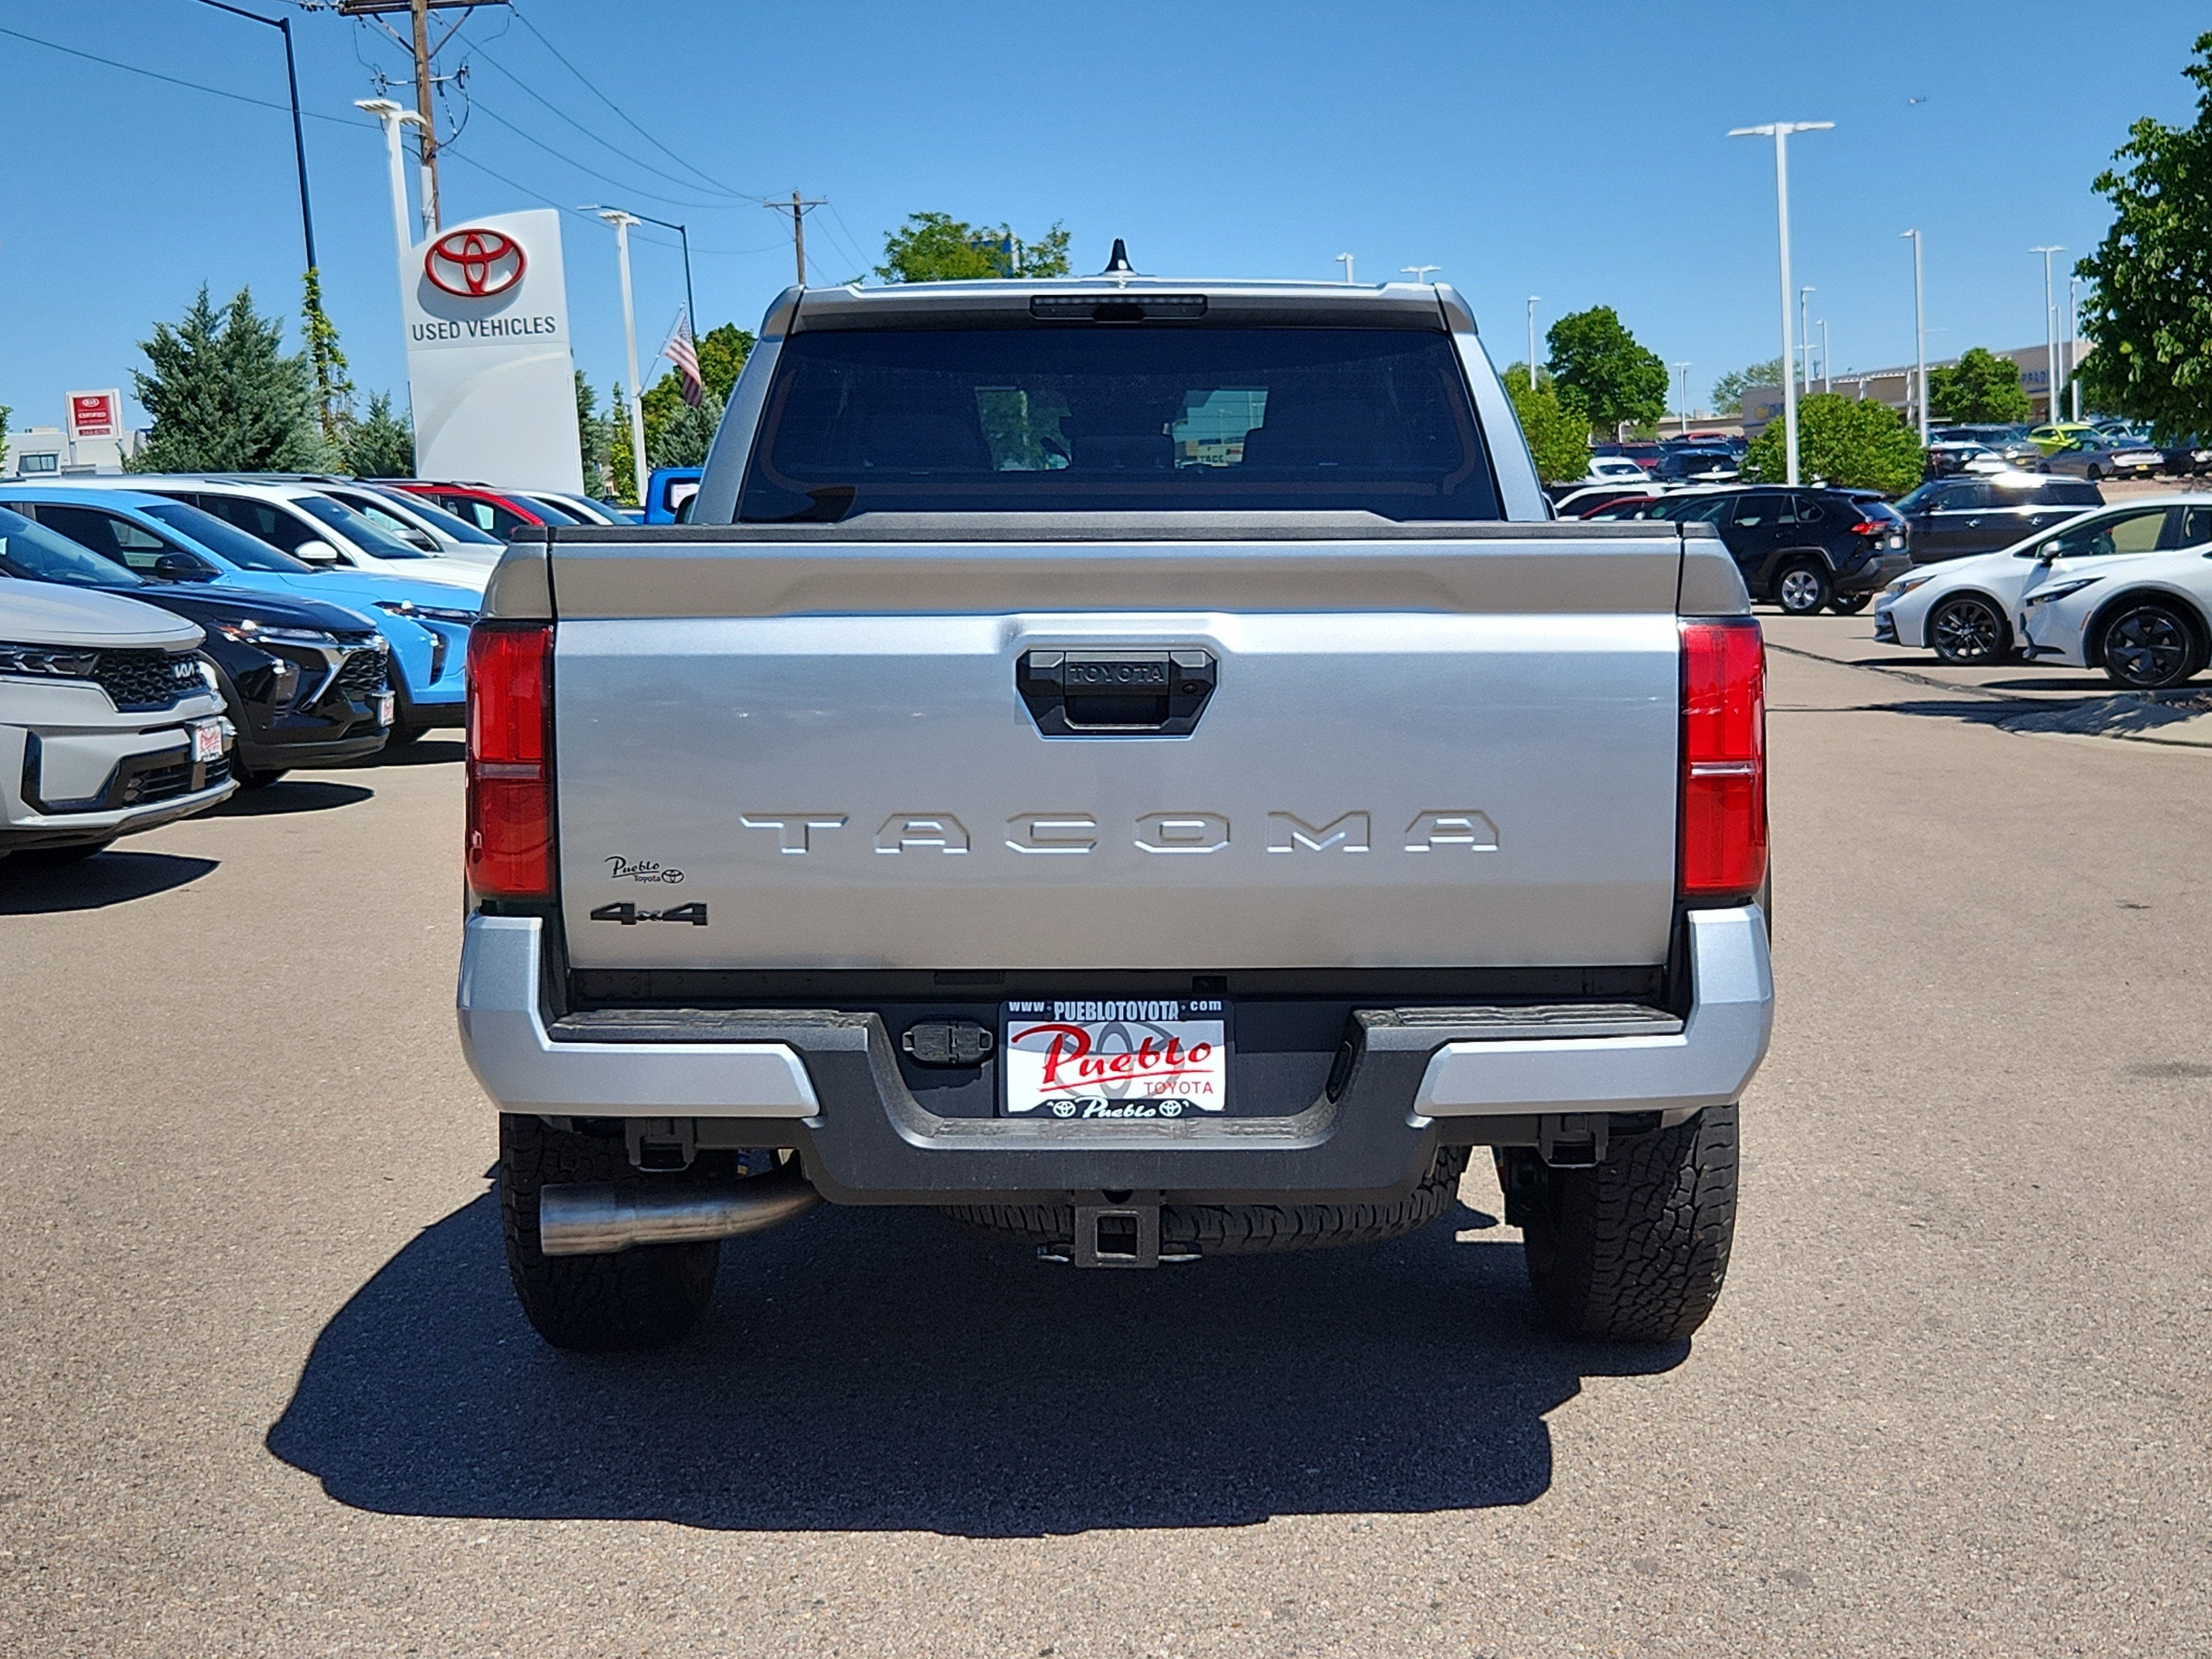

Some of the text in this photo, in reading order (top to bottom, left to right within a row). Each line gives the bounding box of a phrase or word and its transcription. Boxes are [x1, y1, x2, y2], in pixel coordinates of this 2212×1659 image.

[413, 316, 556, 341] USED VEHICLES
[1069, 665, 1165, 683] TOYOTA
[740, 810, 1499, 855] TACOMA
[605, 856, 660, 875] Pueblo
[634, 874, 660, 884] Toyota
[590, 902, 708, 925] 4x4
[1011, 1024, 1212, 1084] Pueblo
[1145, 1081, 1214, 1095] TOYOTA
[1075, 1096, 1156, 1118] Pueblo
